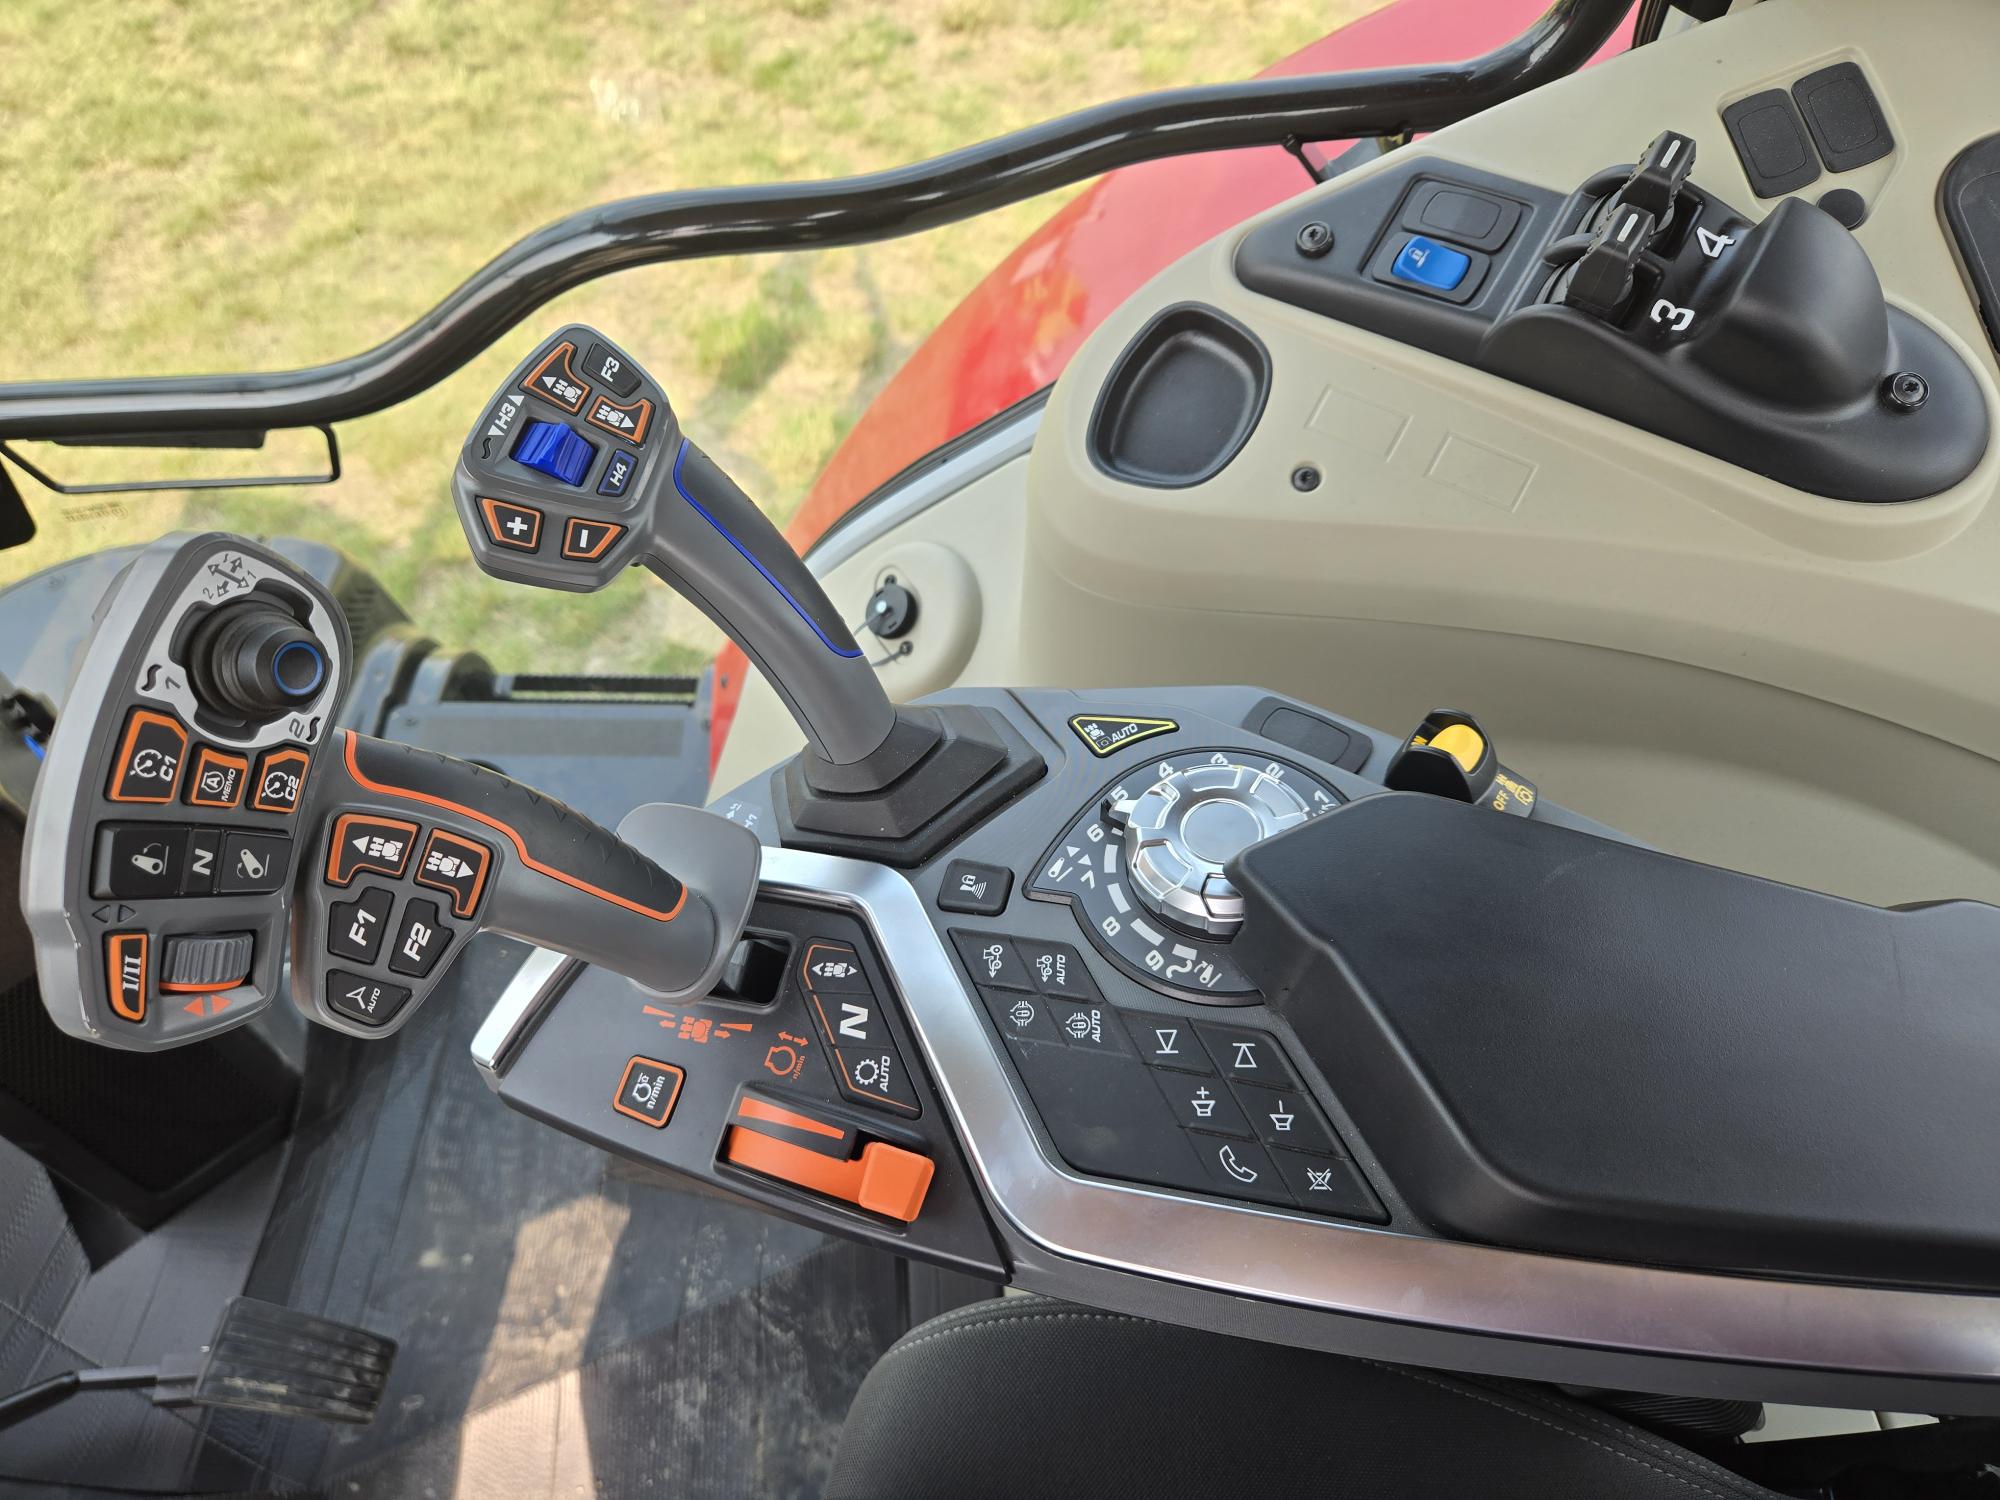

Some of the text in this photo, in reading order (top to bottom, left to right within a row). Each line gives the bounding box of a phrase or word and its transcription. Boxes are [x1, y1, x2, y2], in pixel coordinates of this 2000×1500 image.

[1696, 226, 1736, 258] 4
[1650, 299, 1695, 330] 3
[601, 356, 620, 383] F3
[497, 403, 517, 430] H3
[610, 463, 628, 487] H4
[289, 718, 305, 738] 2
[1111, 723, 1138, 743] AUTO
[159, 755, 177, 782] C1
[1158, 762, 1174, 778] 4
[1210, 753, 1228, 765] 3
[1265, 762, 1285, 778] 2
[221, 768, 237, 802] MEMO
[285, 775, 300, 801] C2
[1110, 786, 1129, 801] 5
[1493, 790, 1510, 812] OFF
[1086, 824, 1105, 842] 6
[192, 848, 214, 876] N
[1080, 870, 1096, 889] 7
[348, 908, 376, 946] F1
[1102, 916, 1122, 937] 8
[403, 922, 432, 962] F2
[1056, 954, 1066, 985] AUTO
[1144, 950, 1165, 971] 9
[366, 987, 381, 1014] AUTO
[839, 1002, 869, 1040] N
[1091, 1009, 1101, 1042] AUTO
[792, 1055, 806, 1080] n/min
[879, 1056, 891, 1092] AUTO
[646, 1075, 665, 1109] n/min
